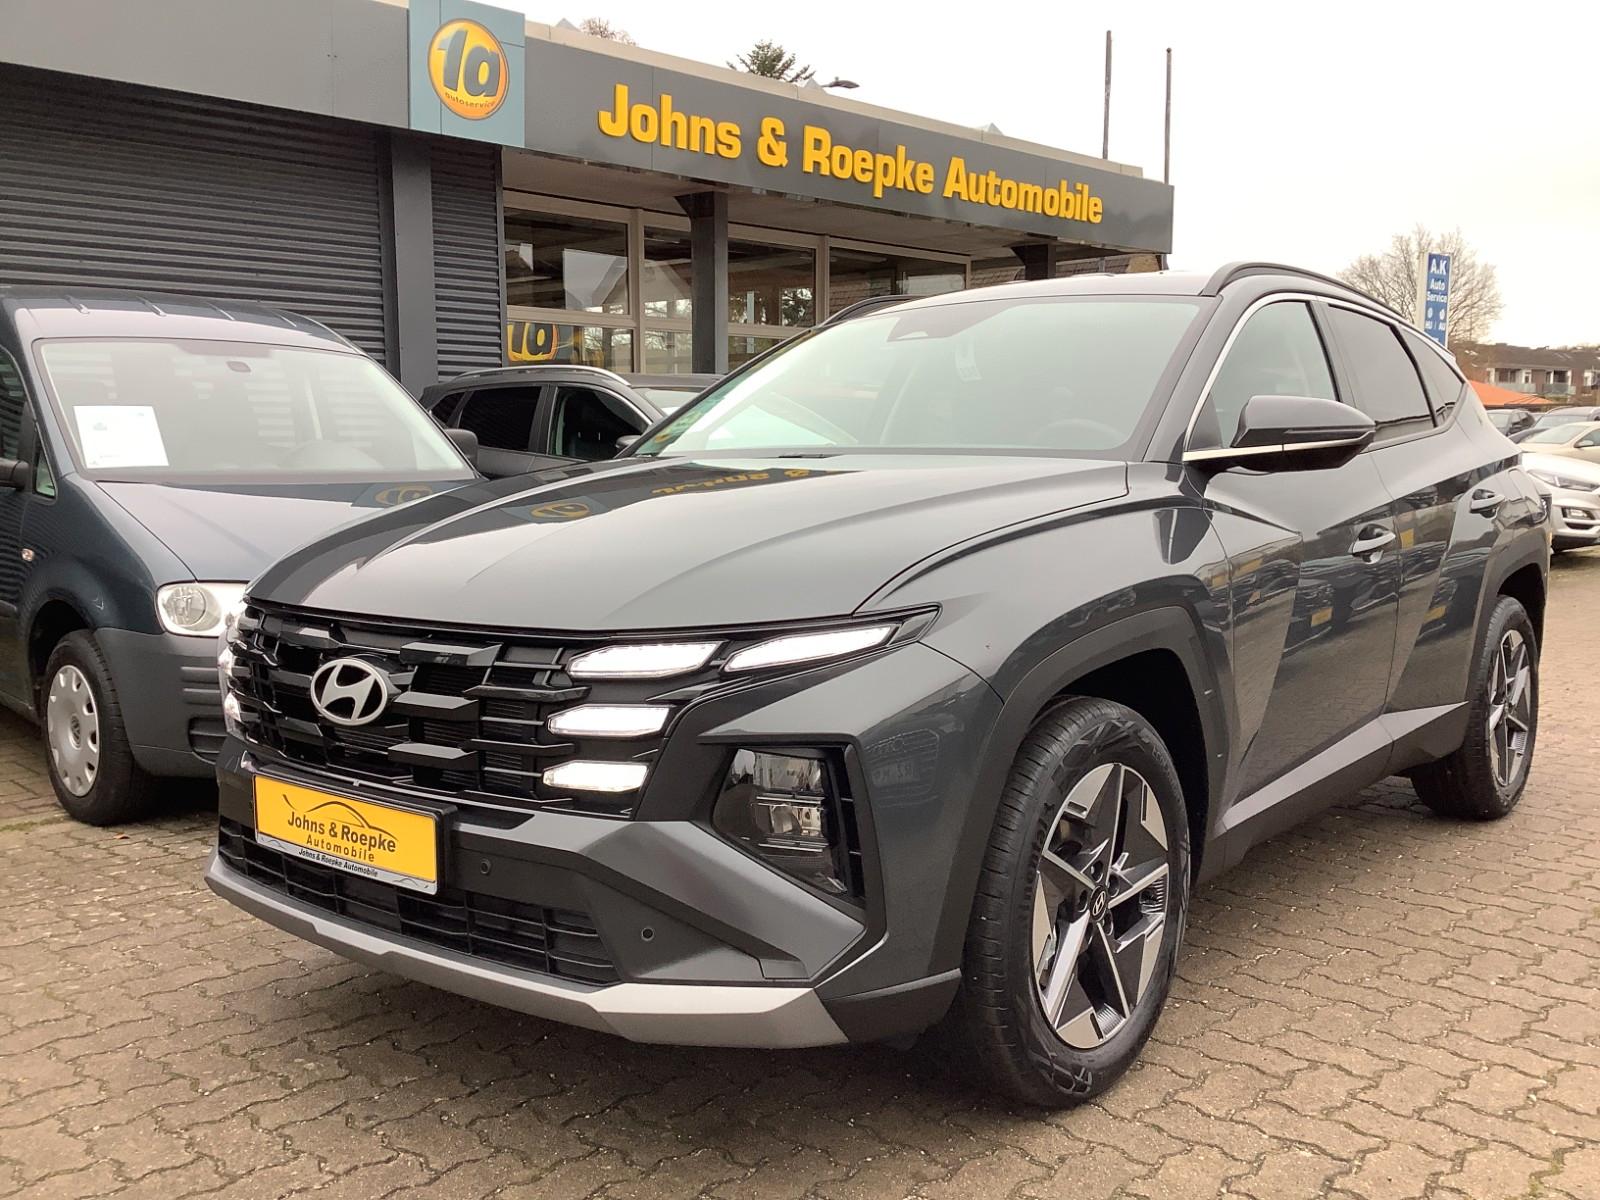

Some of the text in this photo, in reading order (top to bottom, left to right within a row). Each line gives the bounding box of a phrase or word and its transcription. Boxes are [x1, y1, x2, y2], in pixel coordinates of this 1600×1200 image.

[437, 29, 500, 97] 1a
[444, 91, 498, 108] autoservice
[598, 83, 1104, 224] Johns & Roepke Automobile
[1427, 291, 1448, 303] Service
[1429, 278, 1446, 291] Auto
[287, 811, 396, 852] Johns & Roepke
[306, 834, 375, 862] Automobile
[298, 848, 316, 859] Johns
[320, 854, 343, 867] Roepke
[343, 861, 378, 877] Automobile
